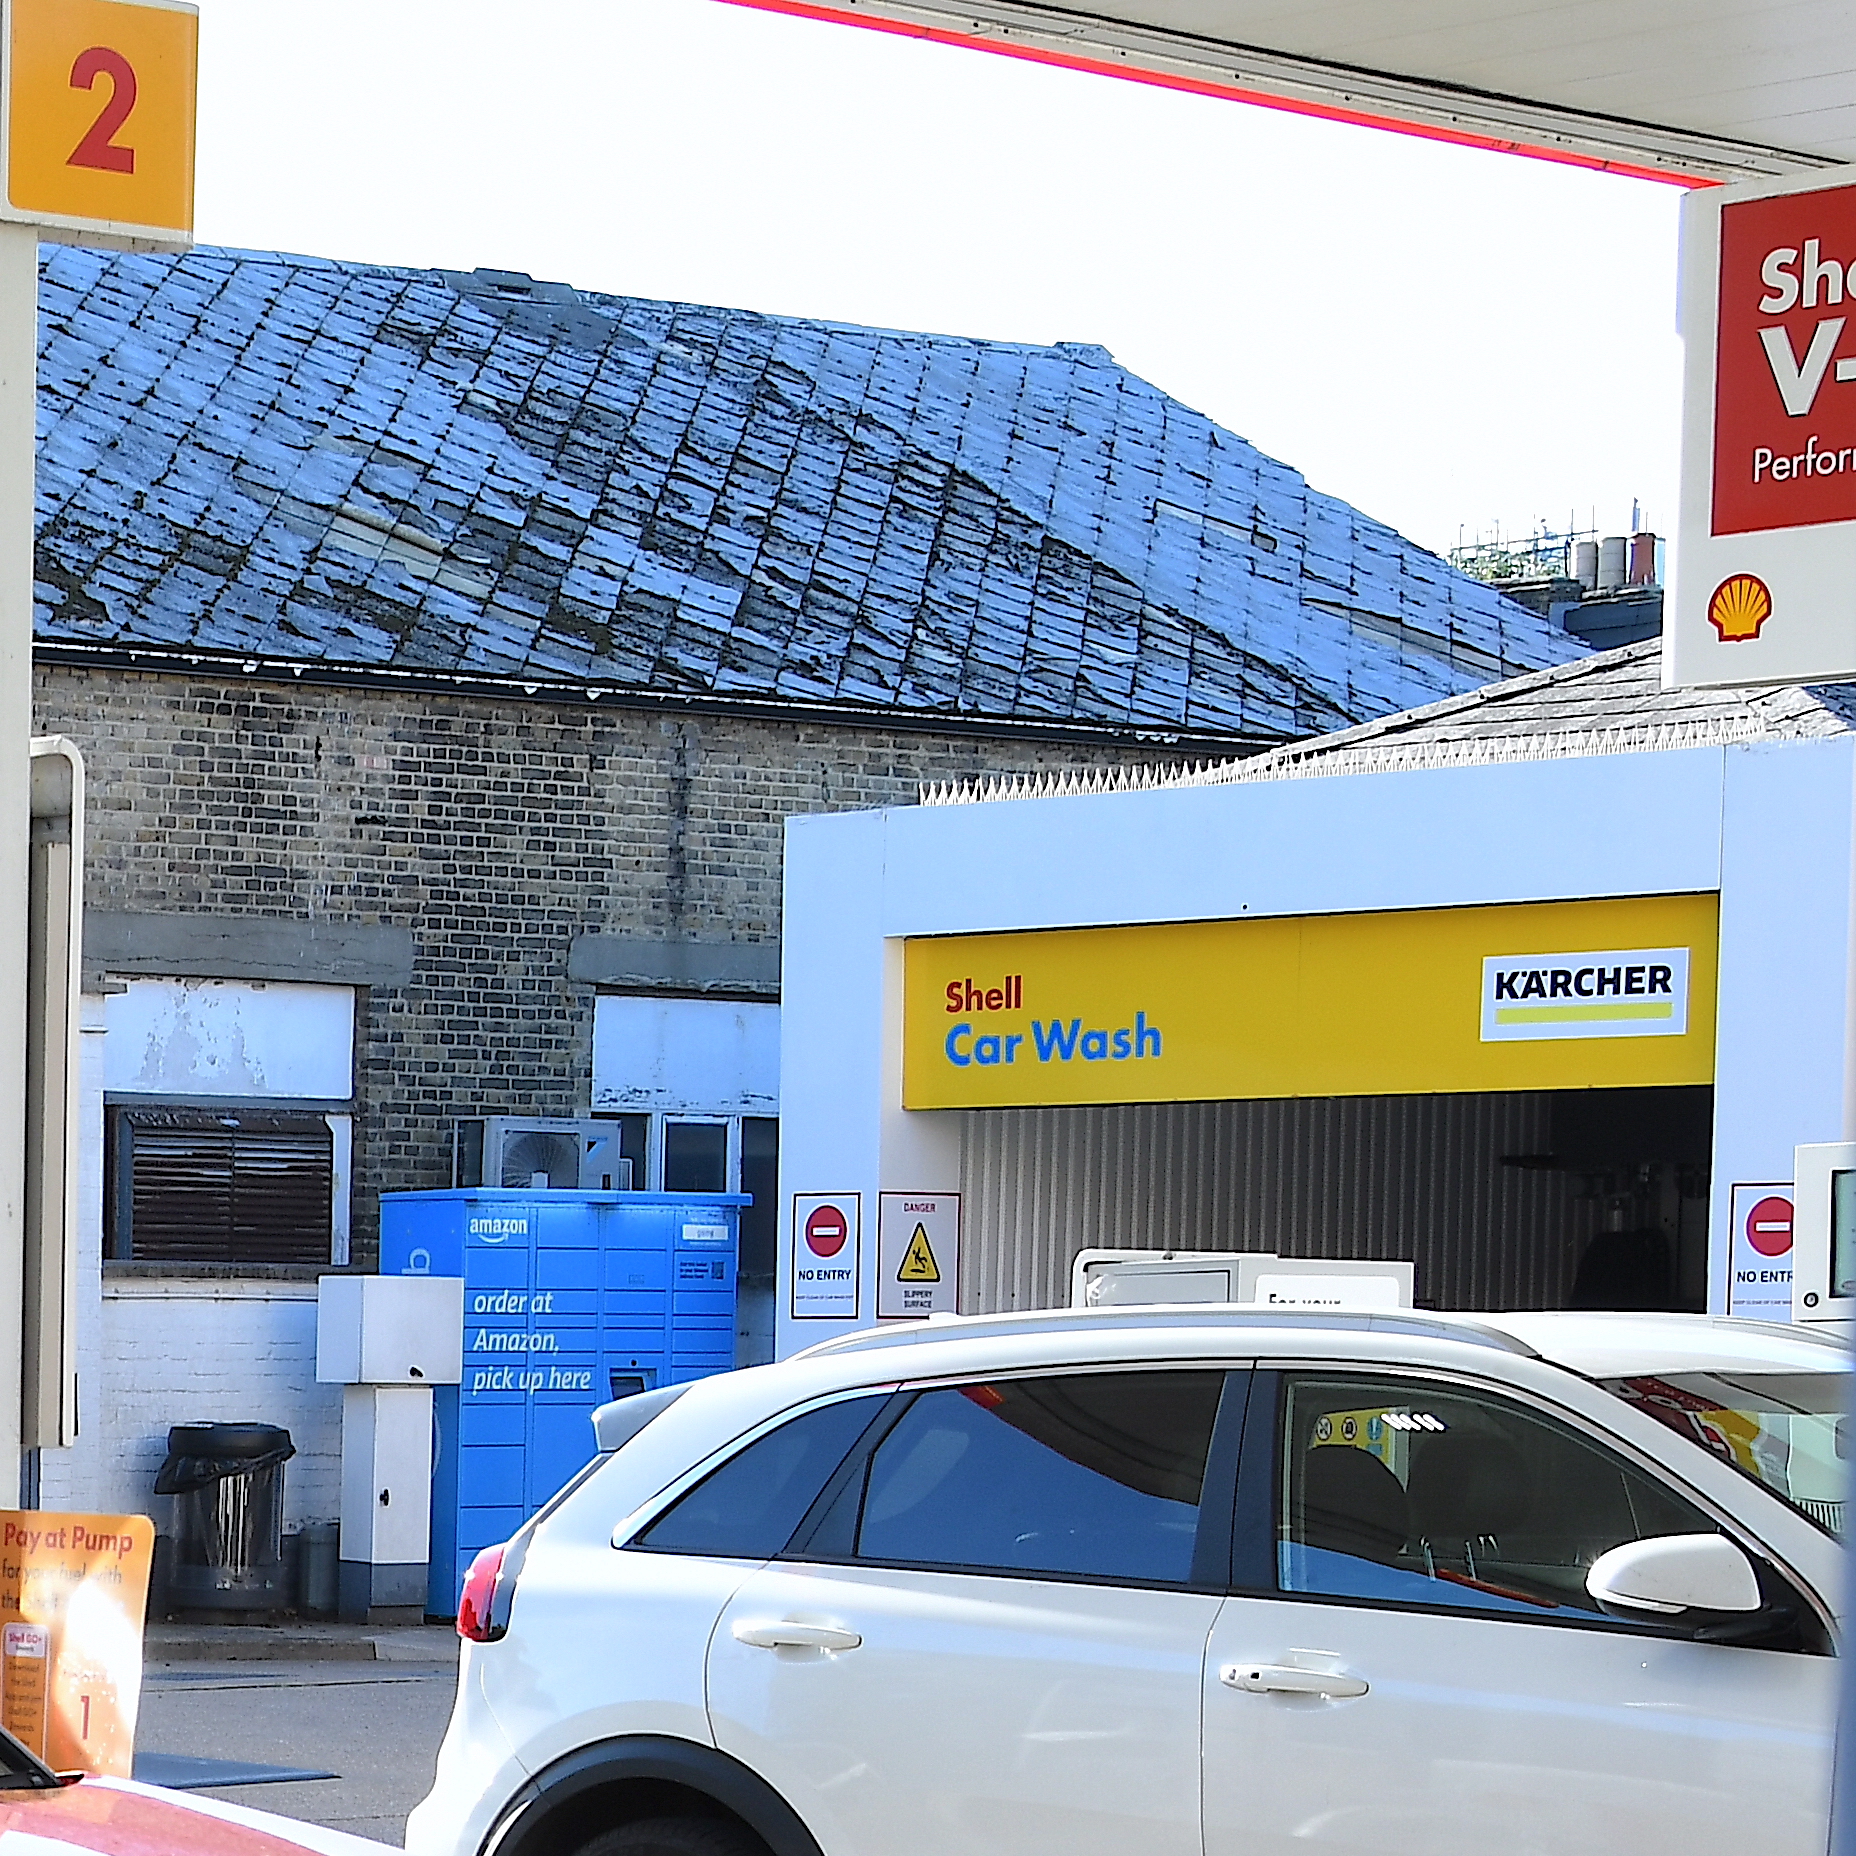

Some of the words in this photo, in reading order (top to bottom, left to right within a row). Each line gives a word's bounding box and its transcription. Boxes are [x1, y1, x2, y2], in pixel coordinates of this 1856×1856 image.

[66, 46, 138, 176] 2
[1757, 238, 1856, 315] Sh
[945, 976, 1023, 1012] Shell
[1494, 964, 1673, 999] KÄRCHER
[945, 1022, 1019, 1067] Car
[1031, 1014, 1162, 1062] Wash
[903, 1203, 936, 1213] DANGER
[469, 1218, 528, 1235] amazon
[798, 1270, 814, 1281] NO
[817, 1269, 851, 1280] ENTRY
[1737, 1271, 1757, 1283] NO
[1760, 1271, 1793, 1283] ENTR
[473, 1289, 526, 1314] order
[531, 1291, 554, 1313] at
[472, 1328, 560, 1355] Amazon,
[472, 1367, 513, 1396] pick
[518, 1372, 543, 1395] up
[548, 1368, 591, 1391] here
[4, 1523, 41, 1554] Pay
[45, 1527, 67, 1548] at
[72, 1526, 133, 1559] Pump
[2, 1559, 20, 1579] for
[80, 1695, 90, 1740] 1
